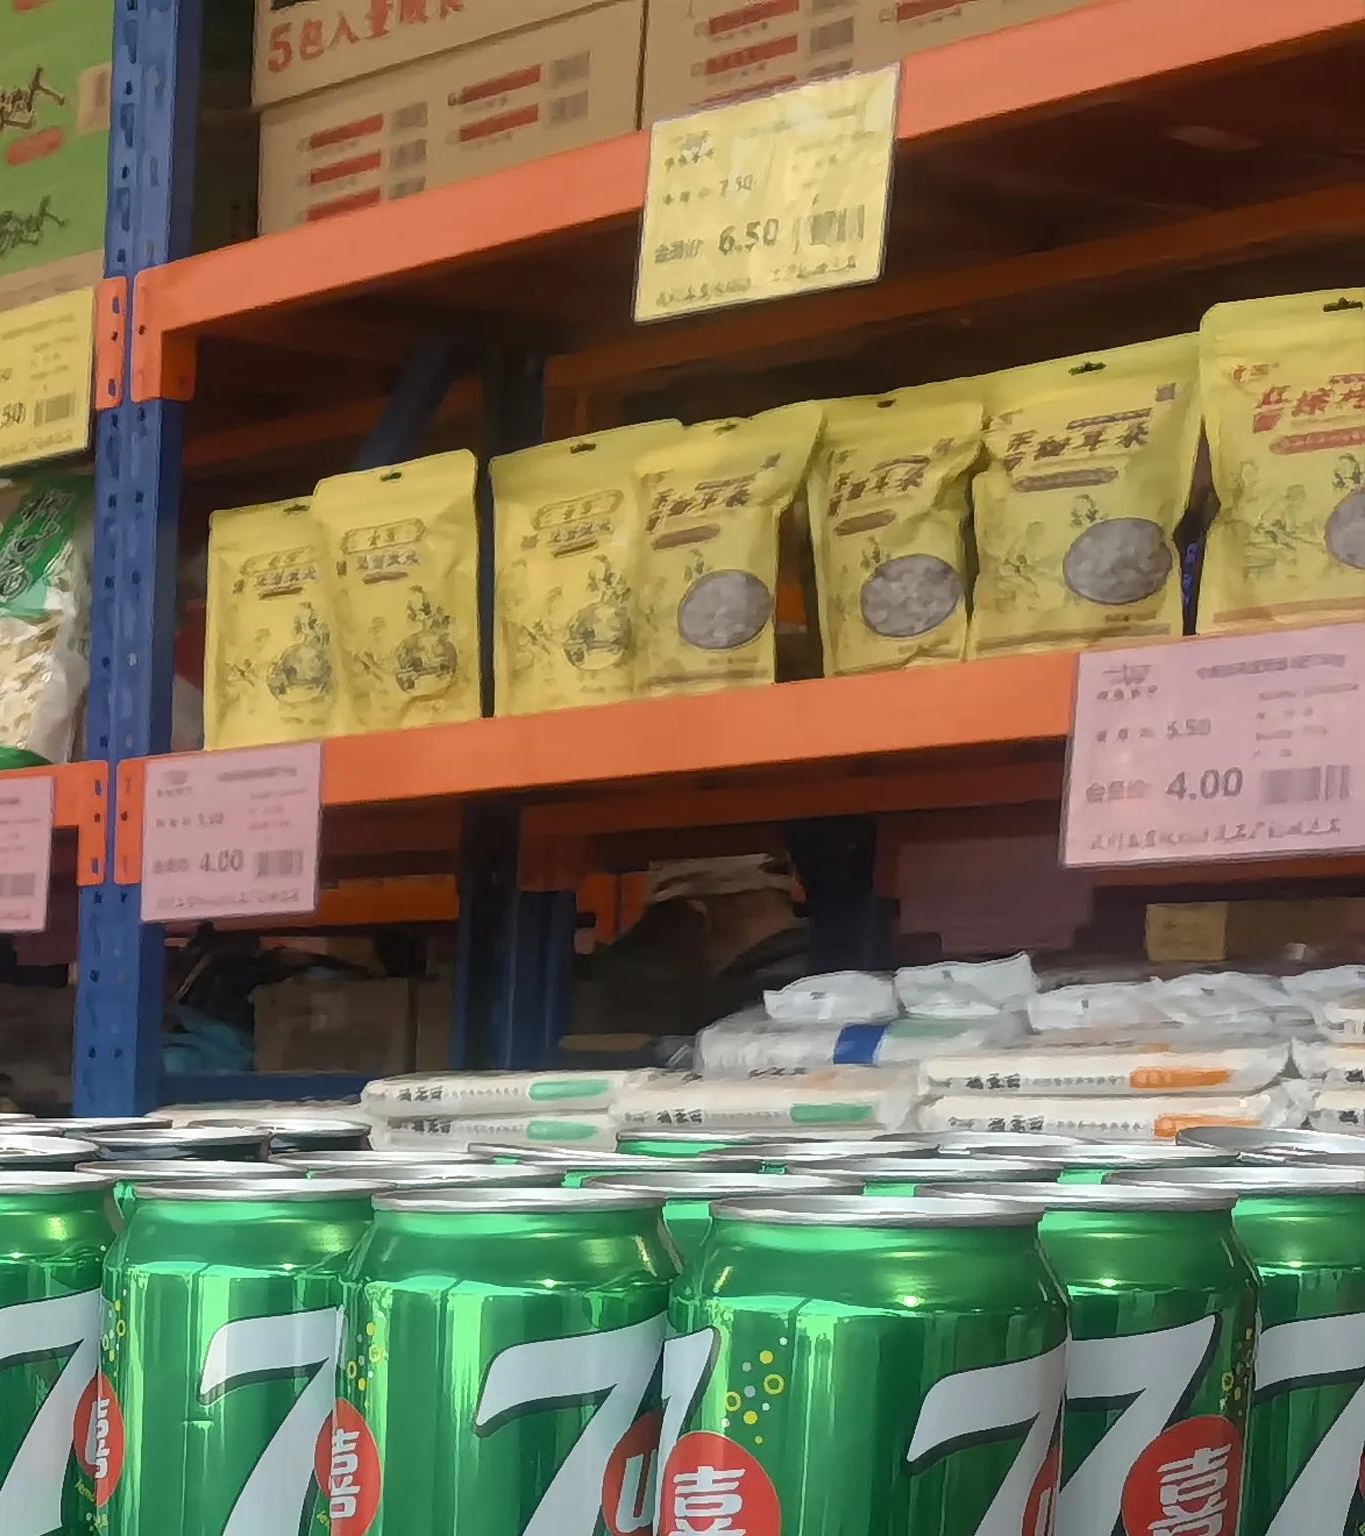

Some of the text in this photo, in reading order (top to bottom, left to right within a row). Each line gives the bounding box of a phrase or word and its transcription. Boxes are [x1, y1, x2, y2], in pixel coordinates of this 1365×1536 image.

[718, 217, 780, 256] 6.50
[1166, 766, 1244, 801] 4.00
[198, 849, 245, 874] 4.00
